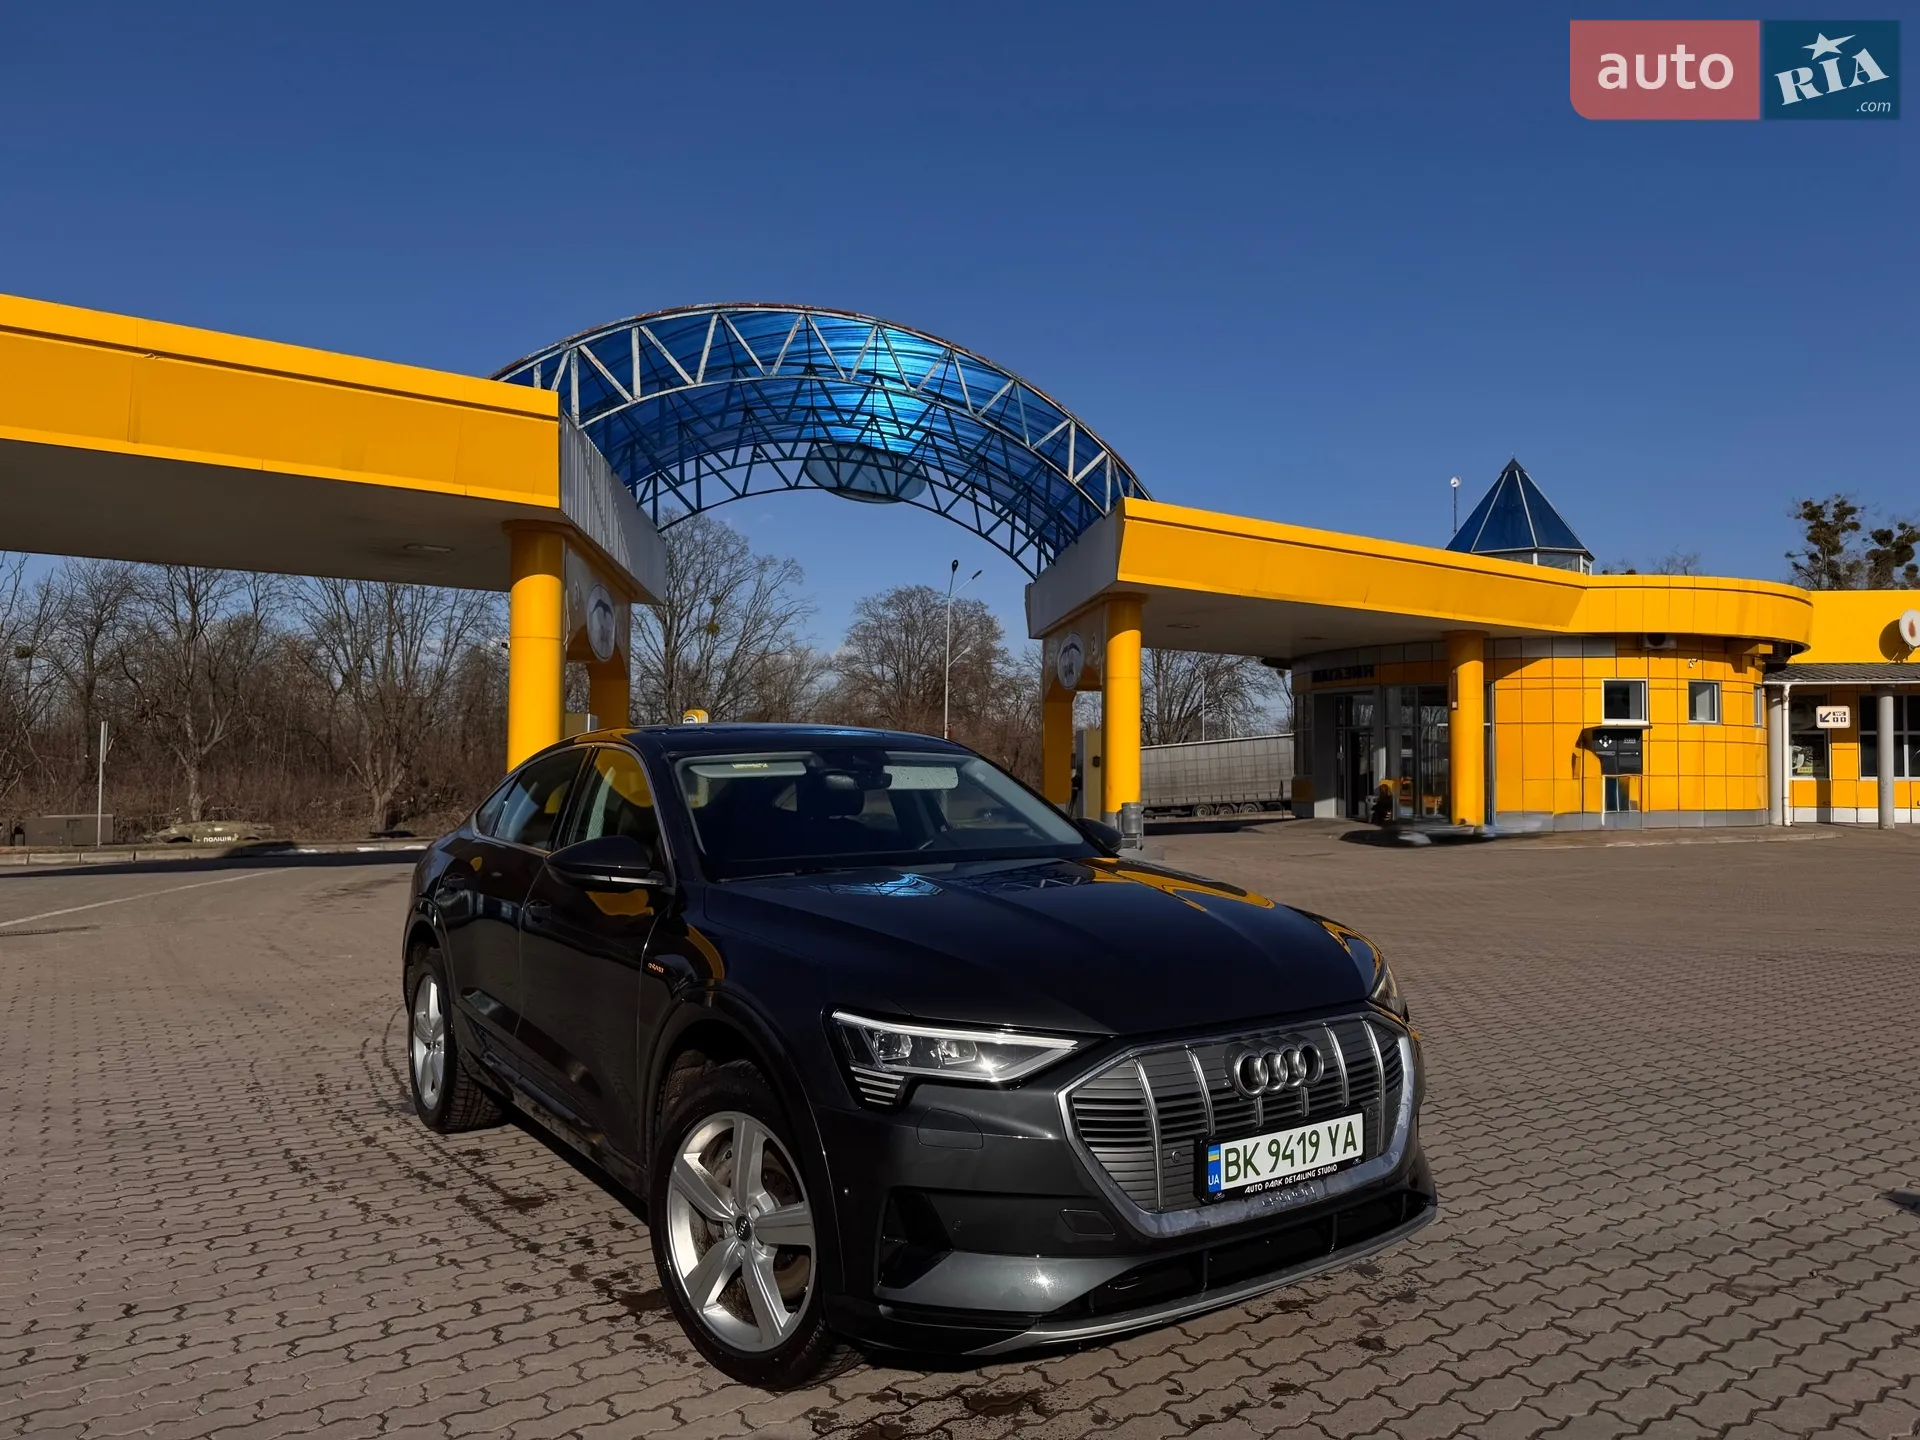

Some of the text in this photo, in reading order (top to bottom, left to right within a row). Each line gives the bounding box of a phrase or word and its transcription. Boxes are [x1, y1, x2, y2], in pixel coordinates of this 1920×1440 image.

[1224, 1121, 1358, 1183] BK 9419 YA
[1208, 1174, 1220, 1186] UA
[1244, 1164, 1338, 1194] AUTO PARK DETAILING STUDIO
